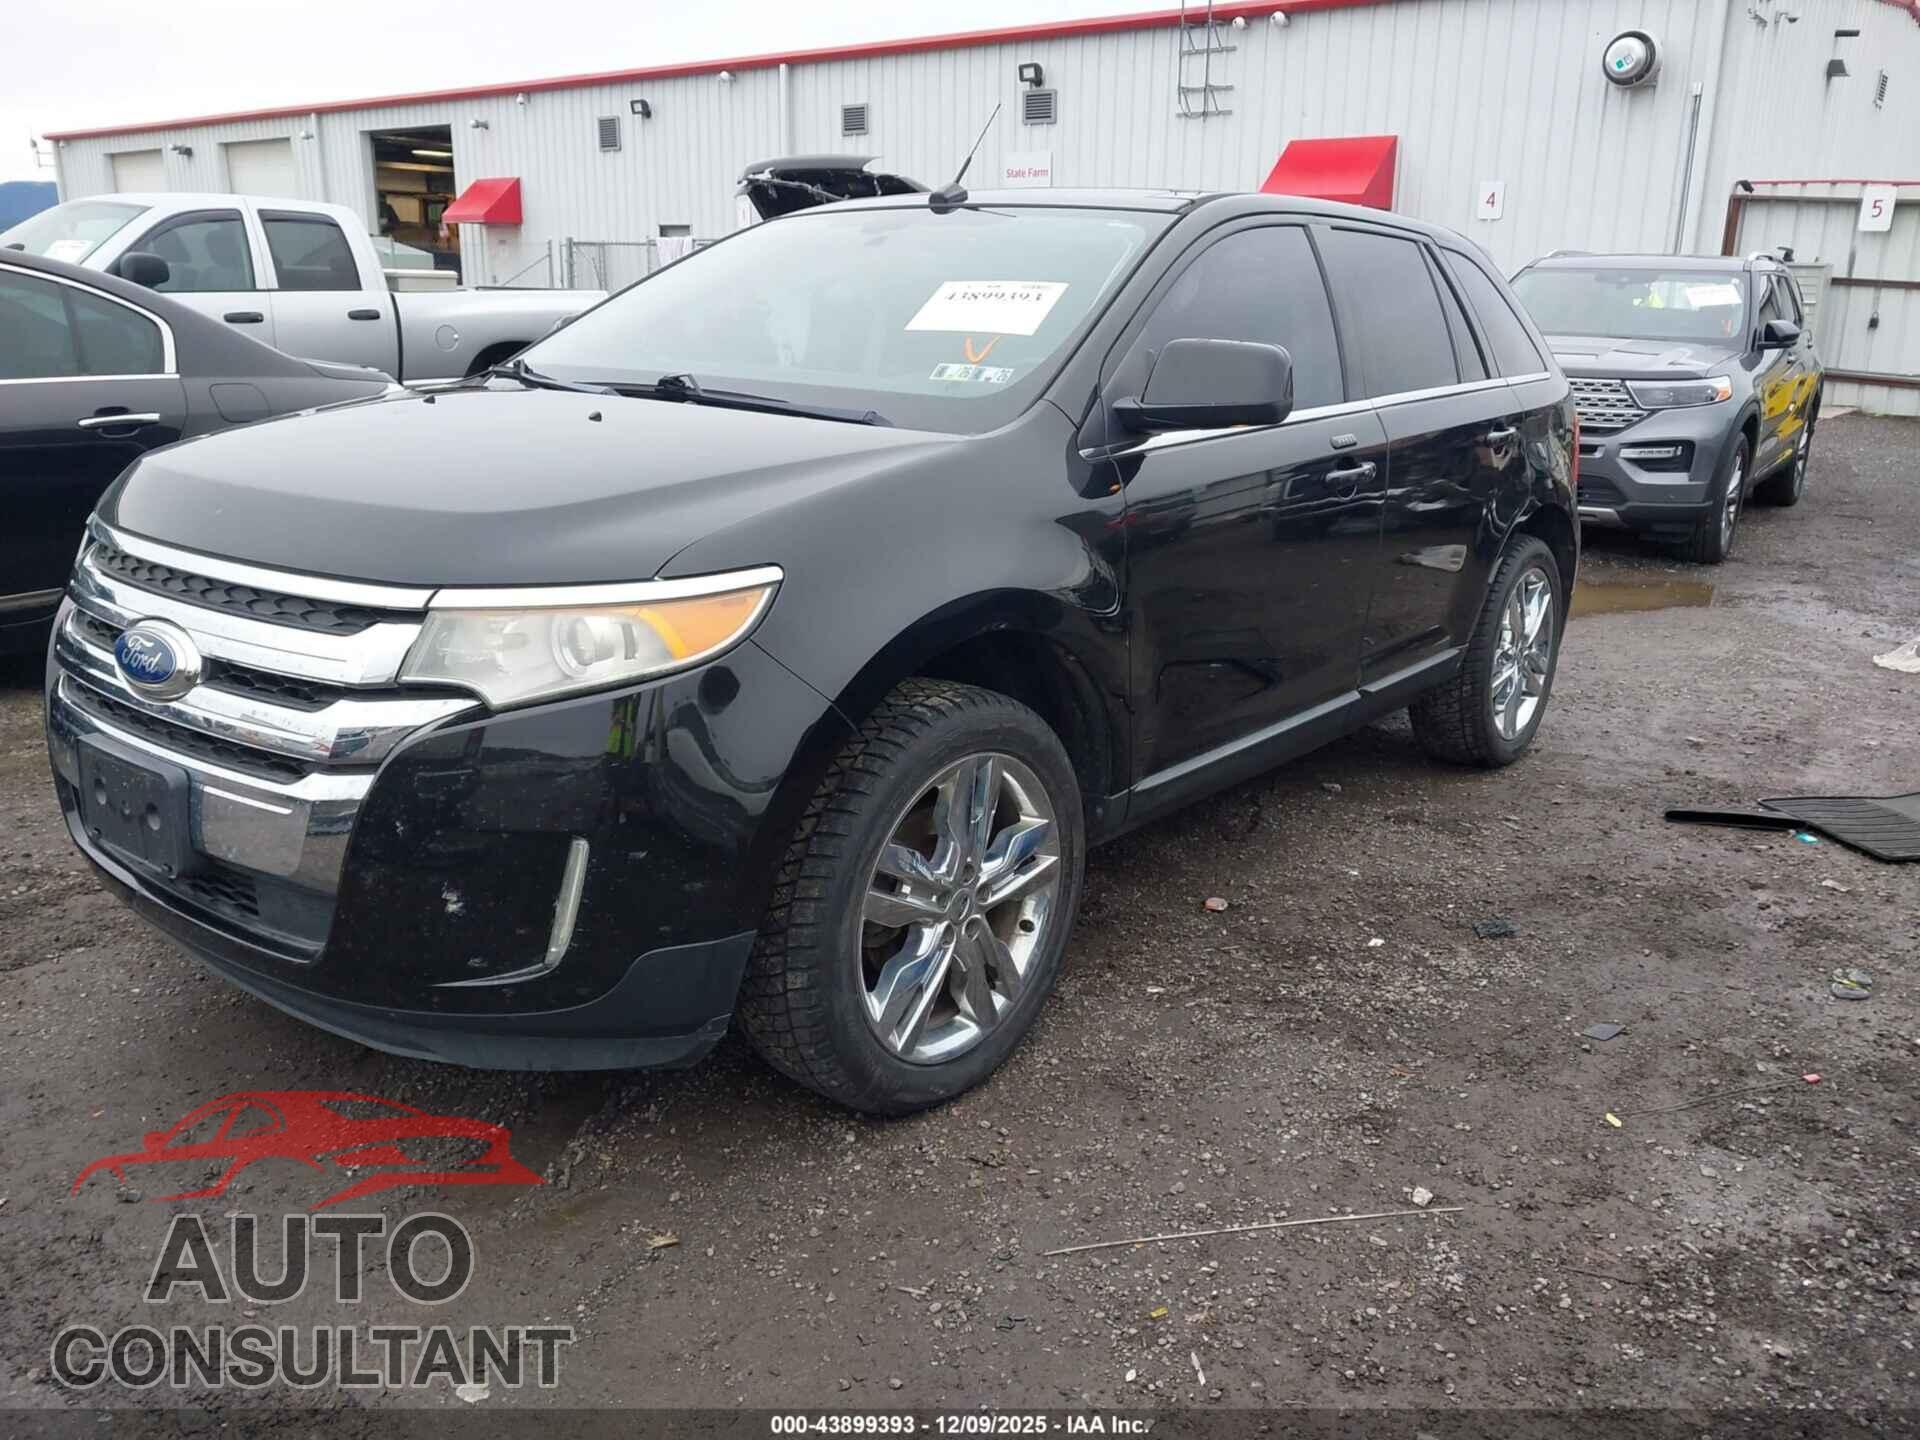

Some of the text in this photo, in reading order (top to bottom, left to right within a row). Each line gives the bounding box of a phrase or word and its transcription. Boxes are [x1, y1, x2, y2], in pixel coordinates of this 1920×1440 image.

[1006, 168, 1049, 178] State Farm
[1486, 191, 1496, 208] 4
[1871, 199, 1884, 218] 5
[121, 635, 163, 673] Ford
